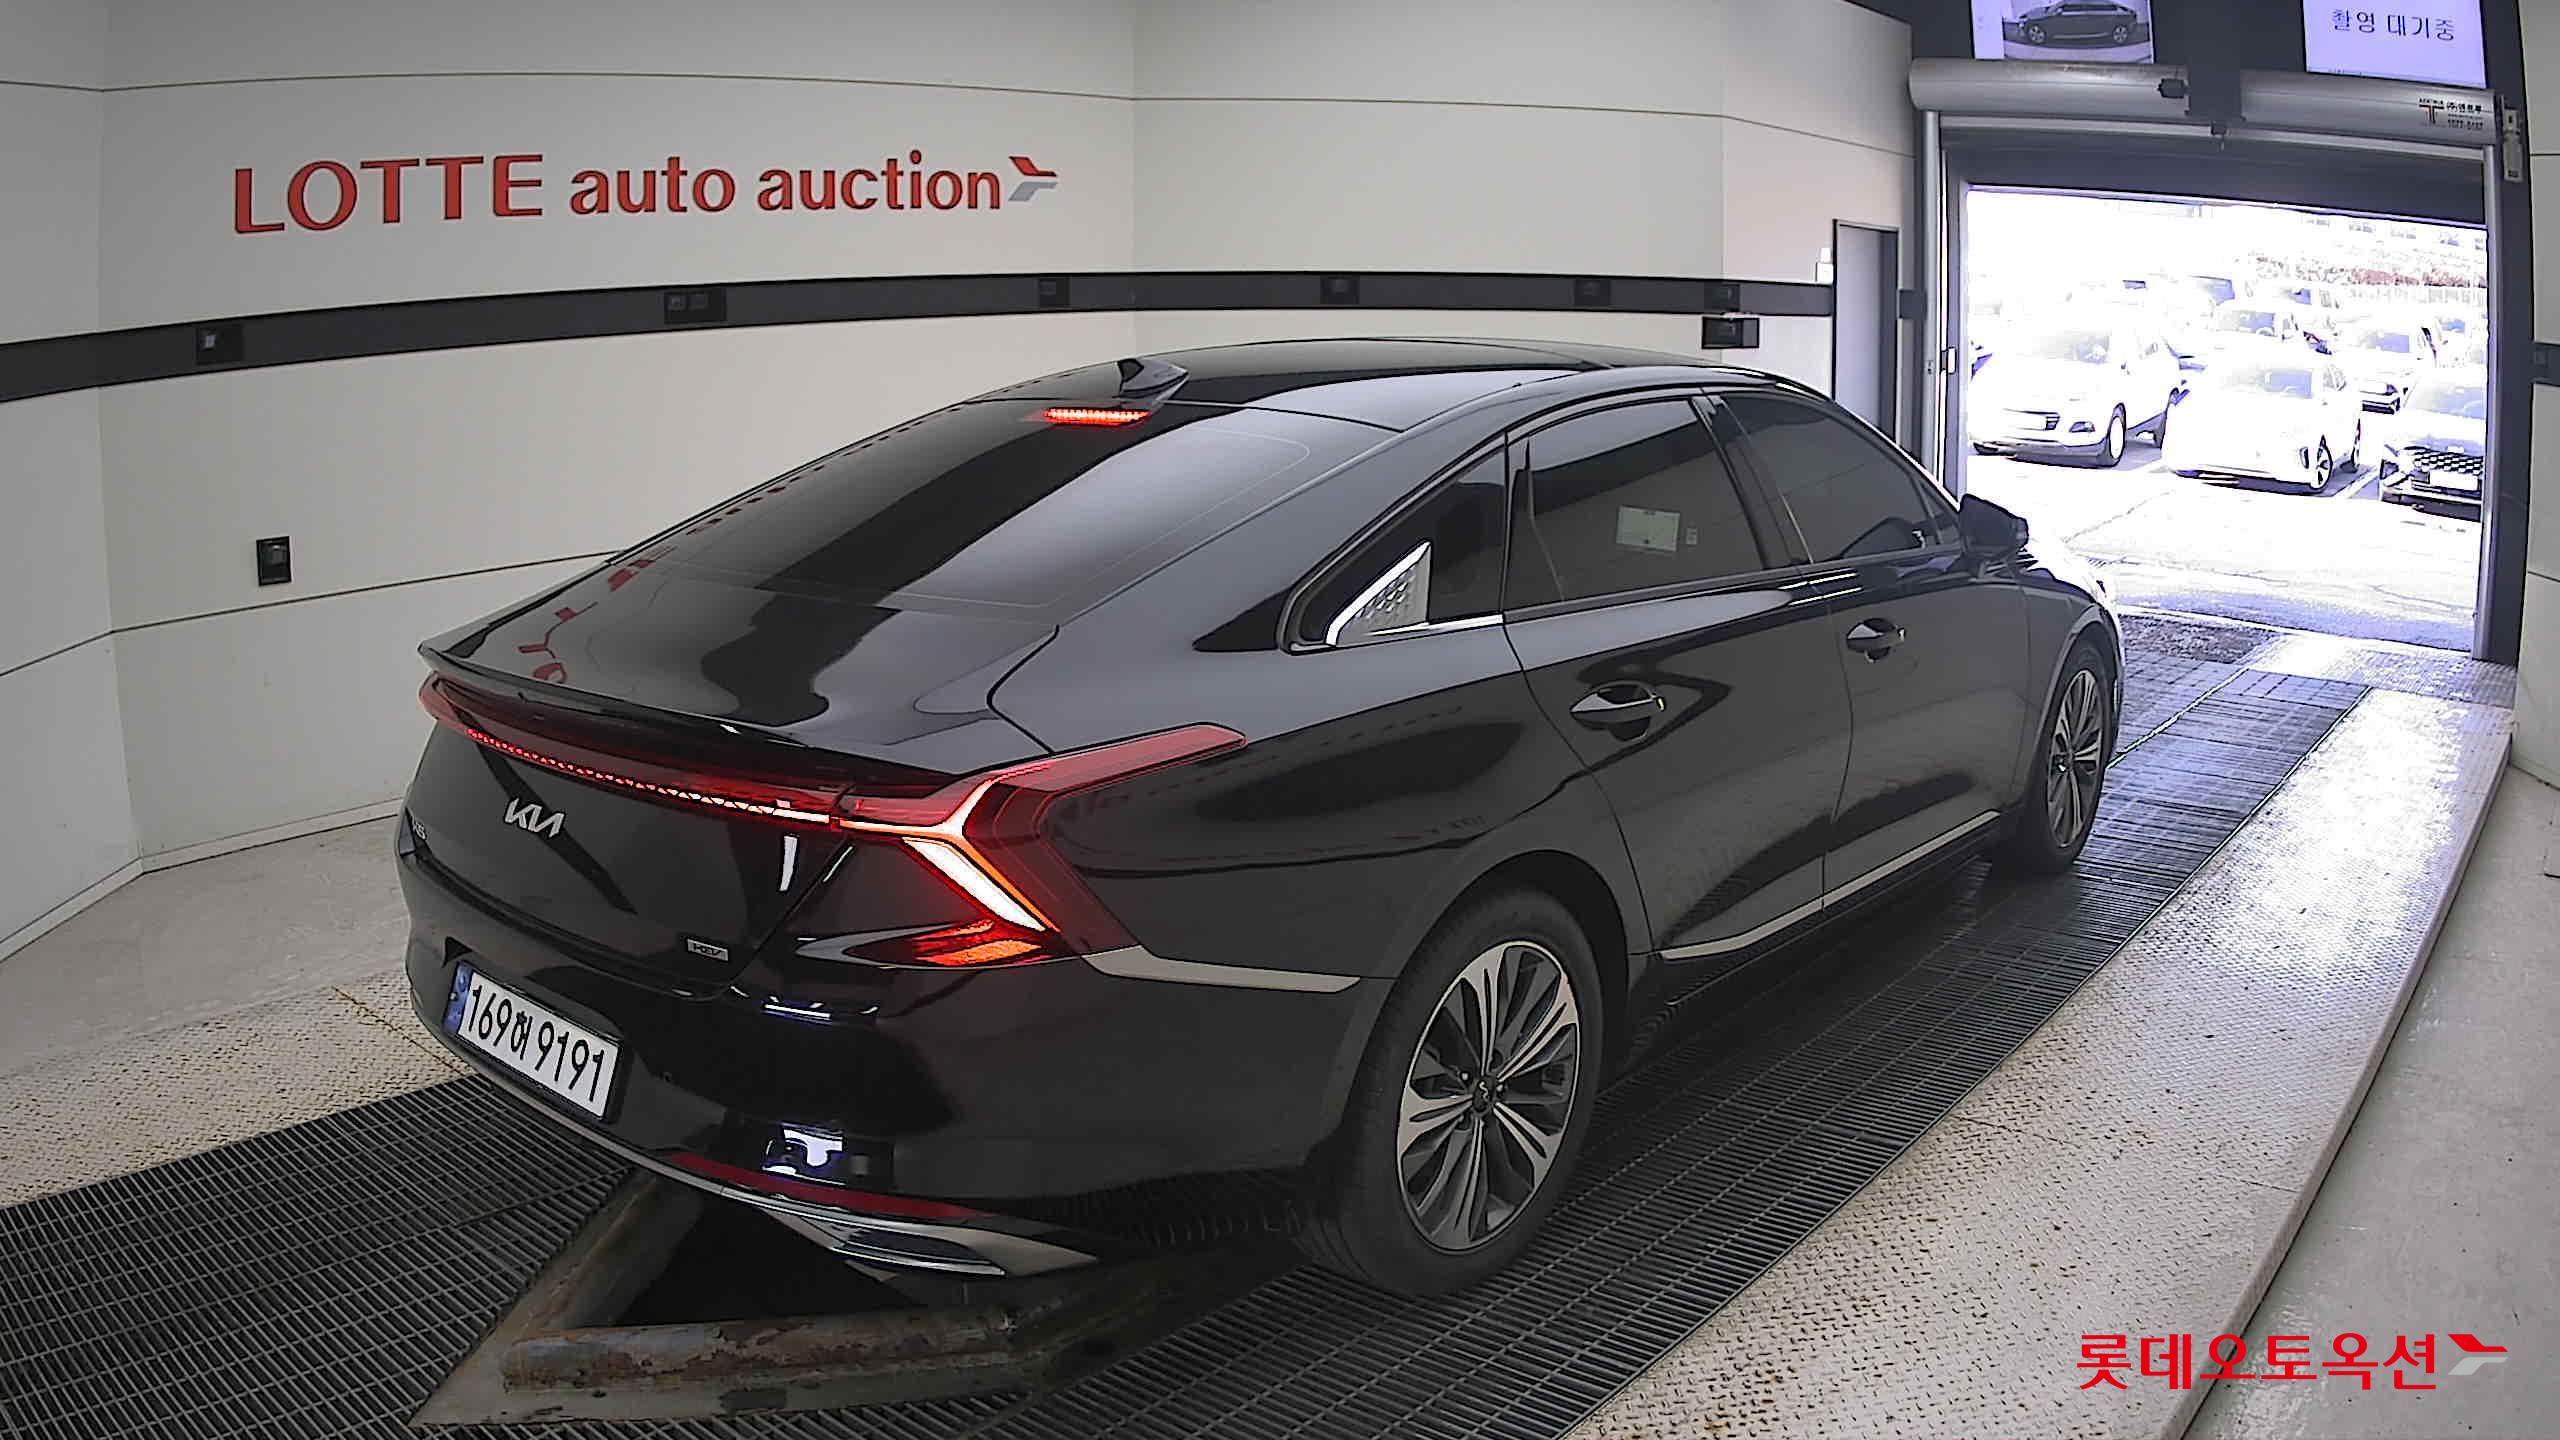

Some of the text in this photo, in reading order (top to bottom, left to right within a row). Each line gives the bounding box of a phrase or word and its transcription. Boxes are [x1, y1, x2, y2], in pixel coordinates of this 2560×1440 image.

[2332, 8, 2455, 41] 촬영 대기중
[235, 149, 1001, 234] LOTTE auto auction
[504, 798, 565, 839] KIA
